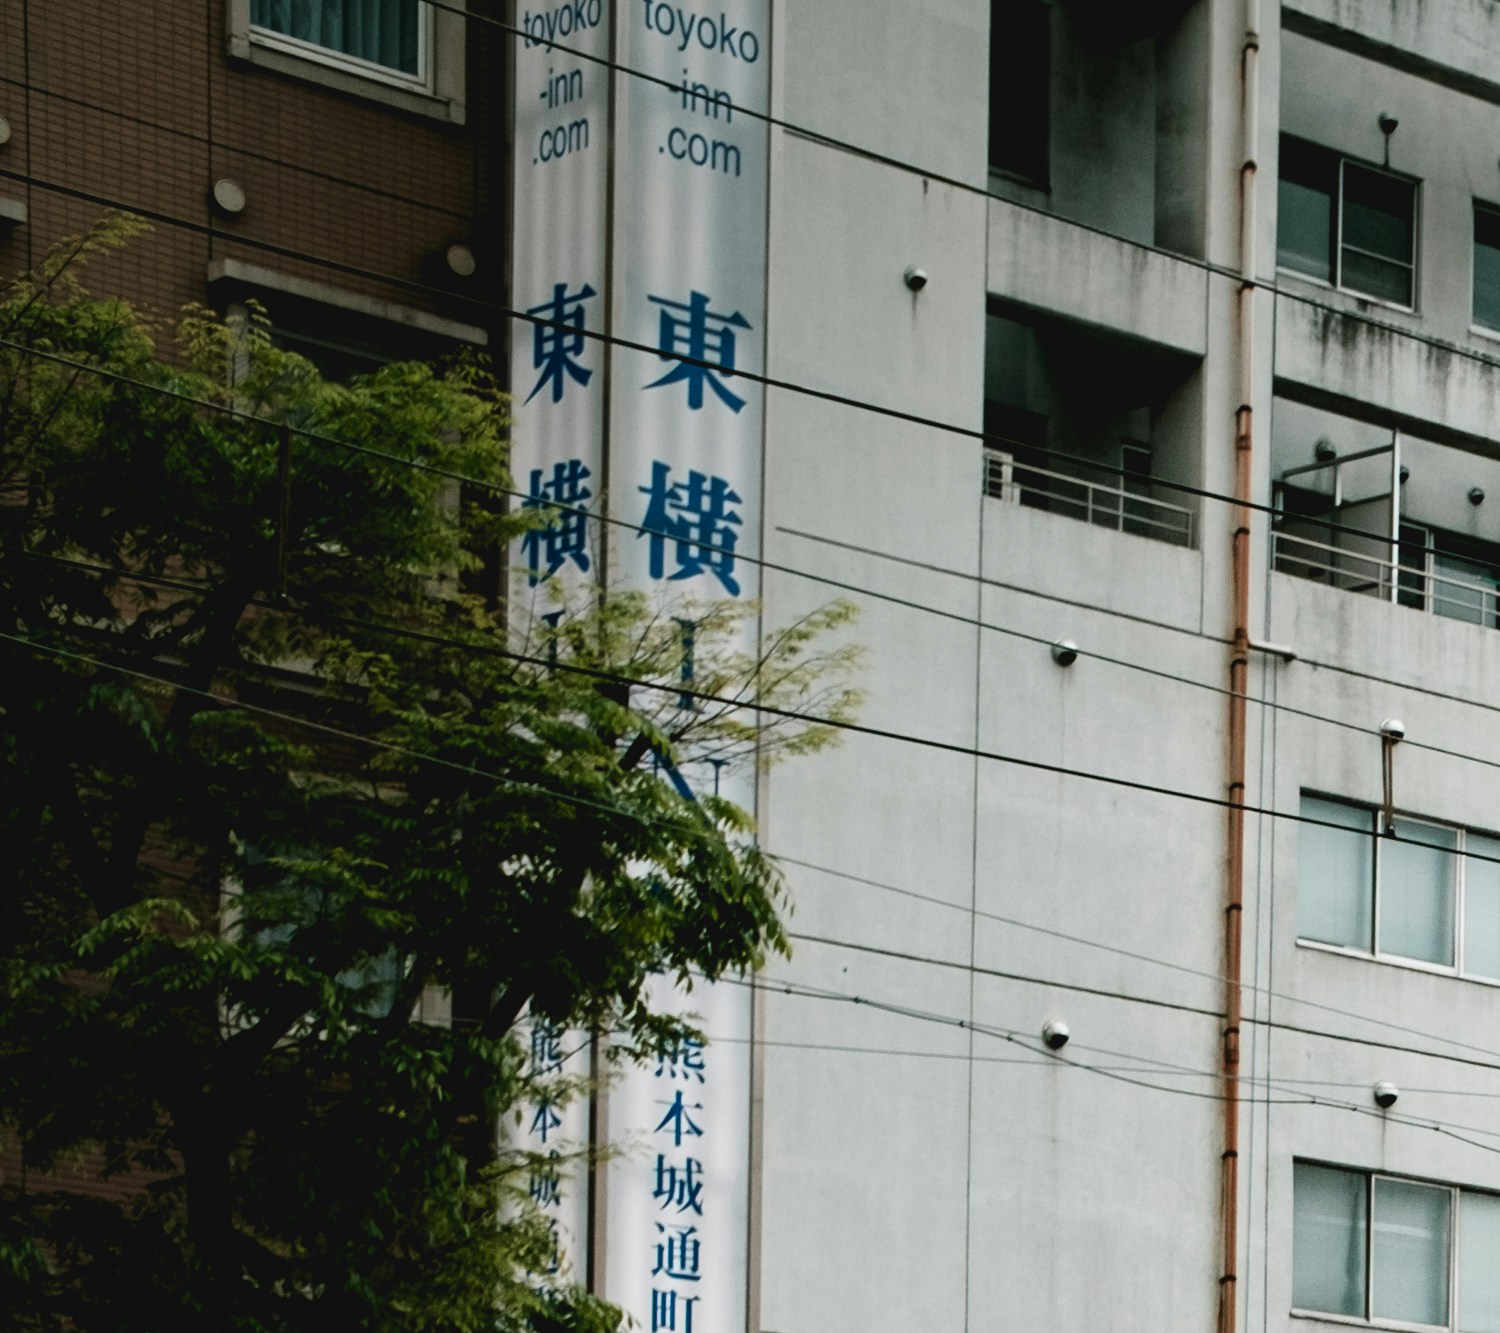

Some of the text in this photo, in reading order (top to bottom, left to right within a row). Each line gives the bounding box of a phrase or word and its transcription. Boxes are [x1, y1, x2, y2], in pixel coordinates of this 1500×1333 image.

[524, 0, 601, 53] toyoko
[643, 0, 759, 63] toyoko
[533, 118, 589, 164] .com
[659, 127, 741, 176] .com
